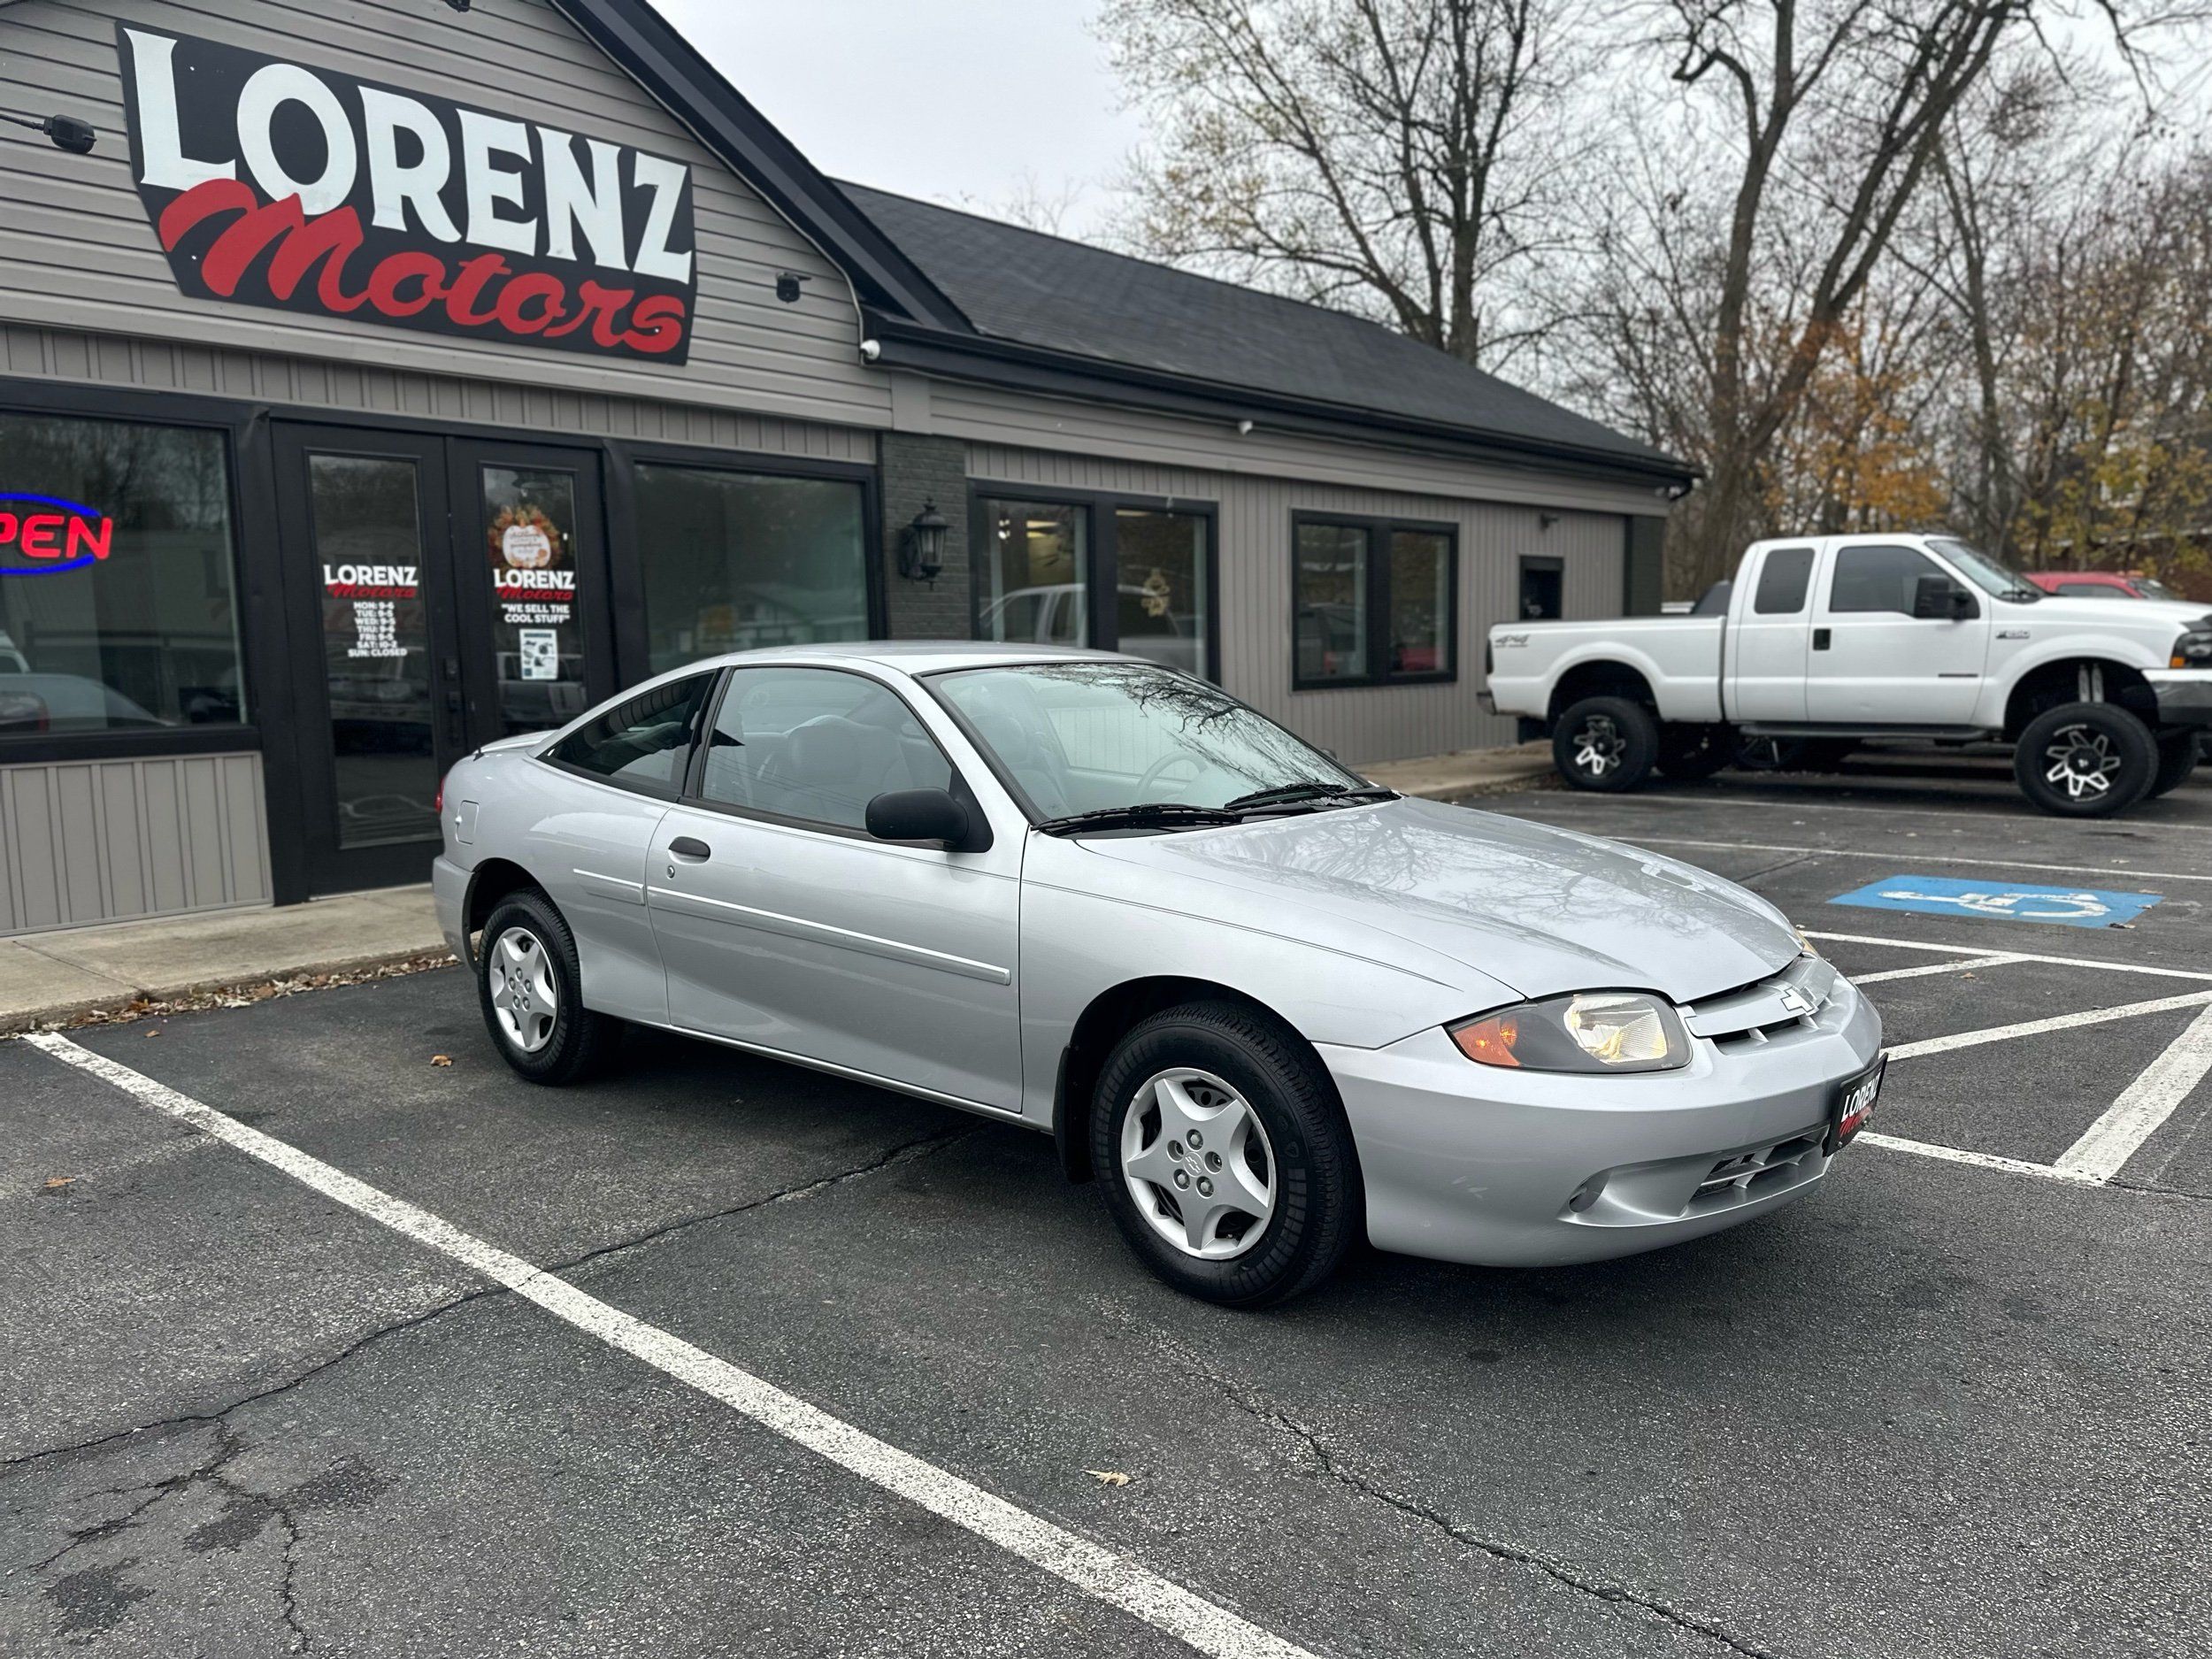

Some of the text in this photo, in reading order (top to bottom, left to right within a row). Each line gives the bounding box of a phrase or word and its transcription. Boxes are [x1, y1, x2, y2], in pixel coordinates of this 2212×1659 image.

[123, 27, 693, 285] LORENZ
[158, 179, 686, 353] Motors
[323, 565, 419, 586] LORENZ
[493, 568, 576, 590] LORENZ
[501, 603, 570, 613] "WE SELL THE
[504, 614, 571, 624] COOL STUFF"
[348, 648, 408, 657] SUN: CLOSED
